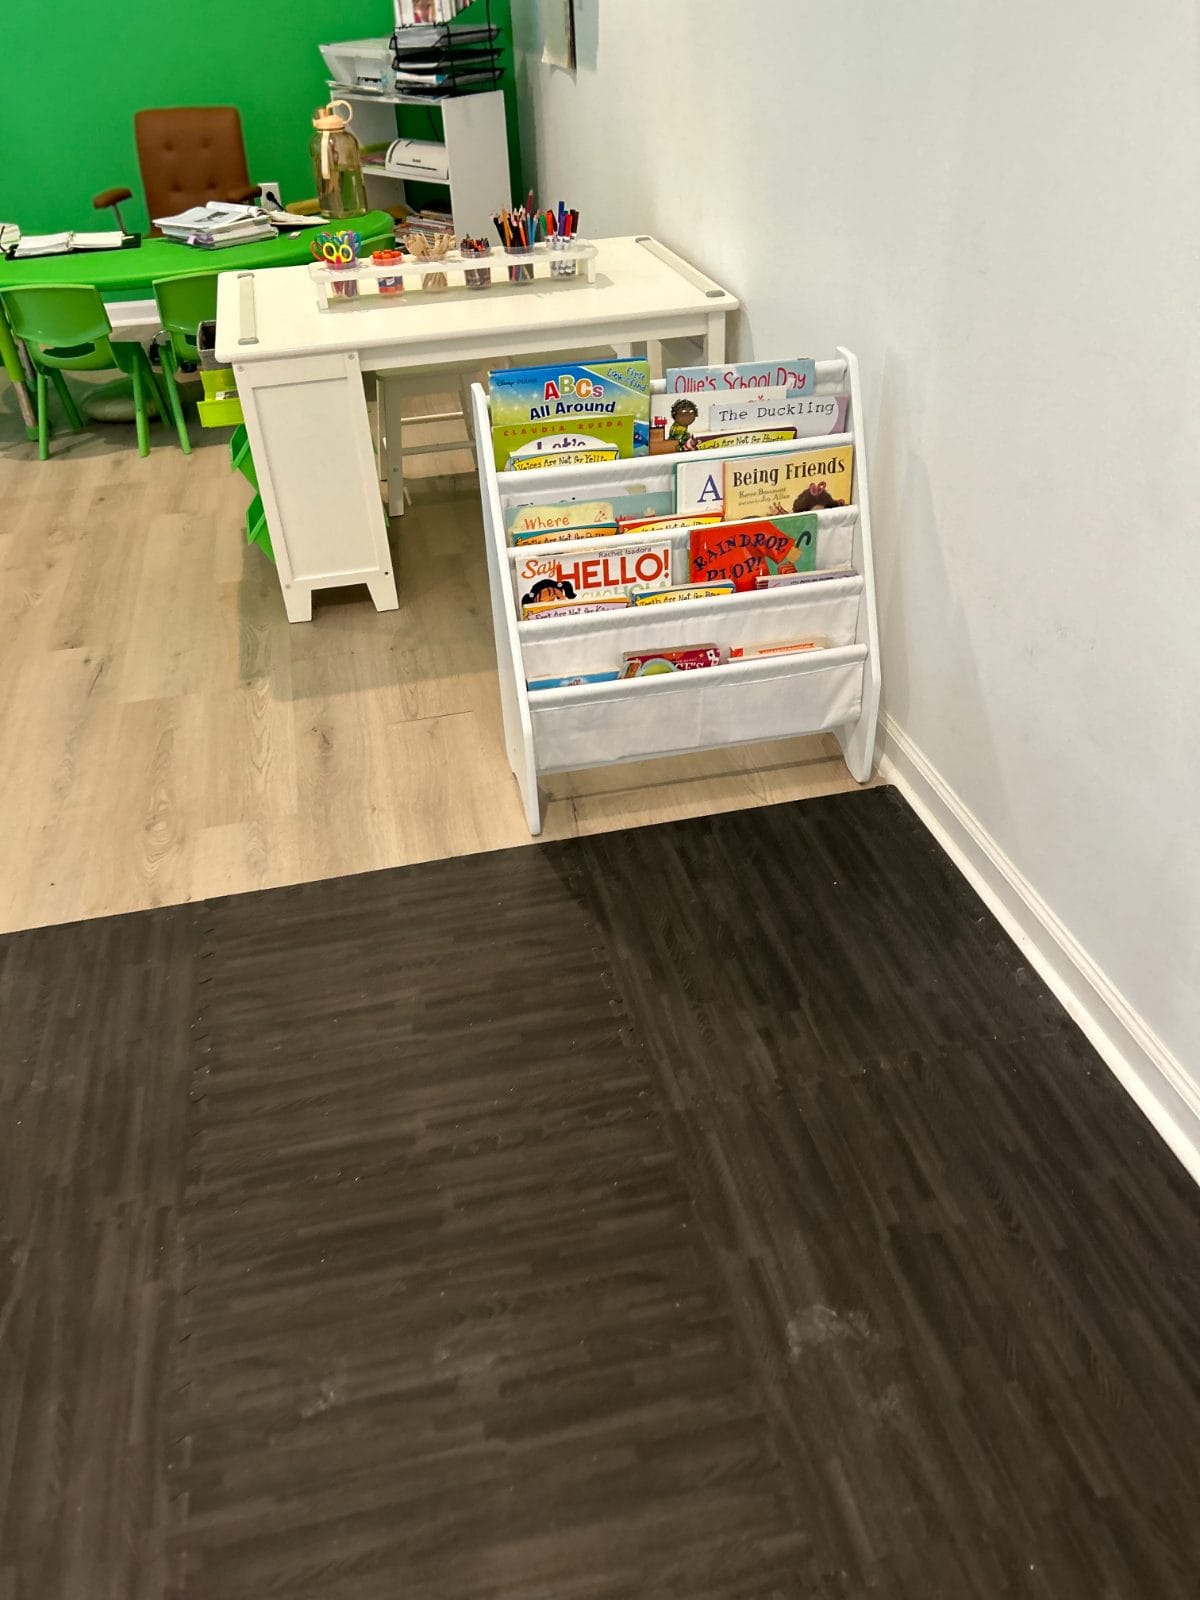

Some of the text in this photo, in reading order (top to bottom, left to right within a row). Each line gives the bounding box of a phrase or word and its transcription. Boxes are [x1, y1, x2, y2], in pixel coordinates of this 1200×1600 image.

[544, 374, 603, 401] ABCs
[776, 367, 806, 389] Day
[531, 401, 615, 420] All Around
[719, 402, 835, 421] The Duckling
[504, 421, 623, 436] CLAUDIA RUEDA
[737, 436, 749, 445] Not
[544, 459, 557, 467] Are
[559, 455, 572, 464] Not
[733, 456, 846, 487] Being Friends
[524, 516, 570, 530] Where
[693, 533, 789, 571] RAINDROP
[556, 549, 669, 590] HELLO!
[707, 556, 762, 581] PLOP!
